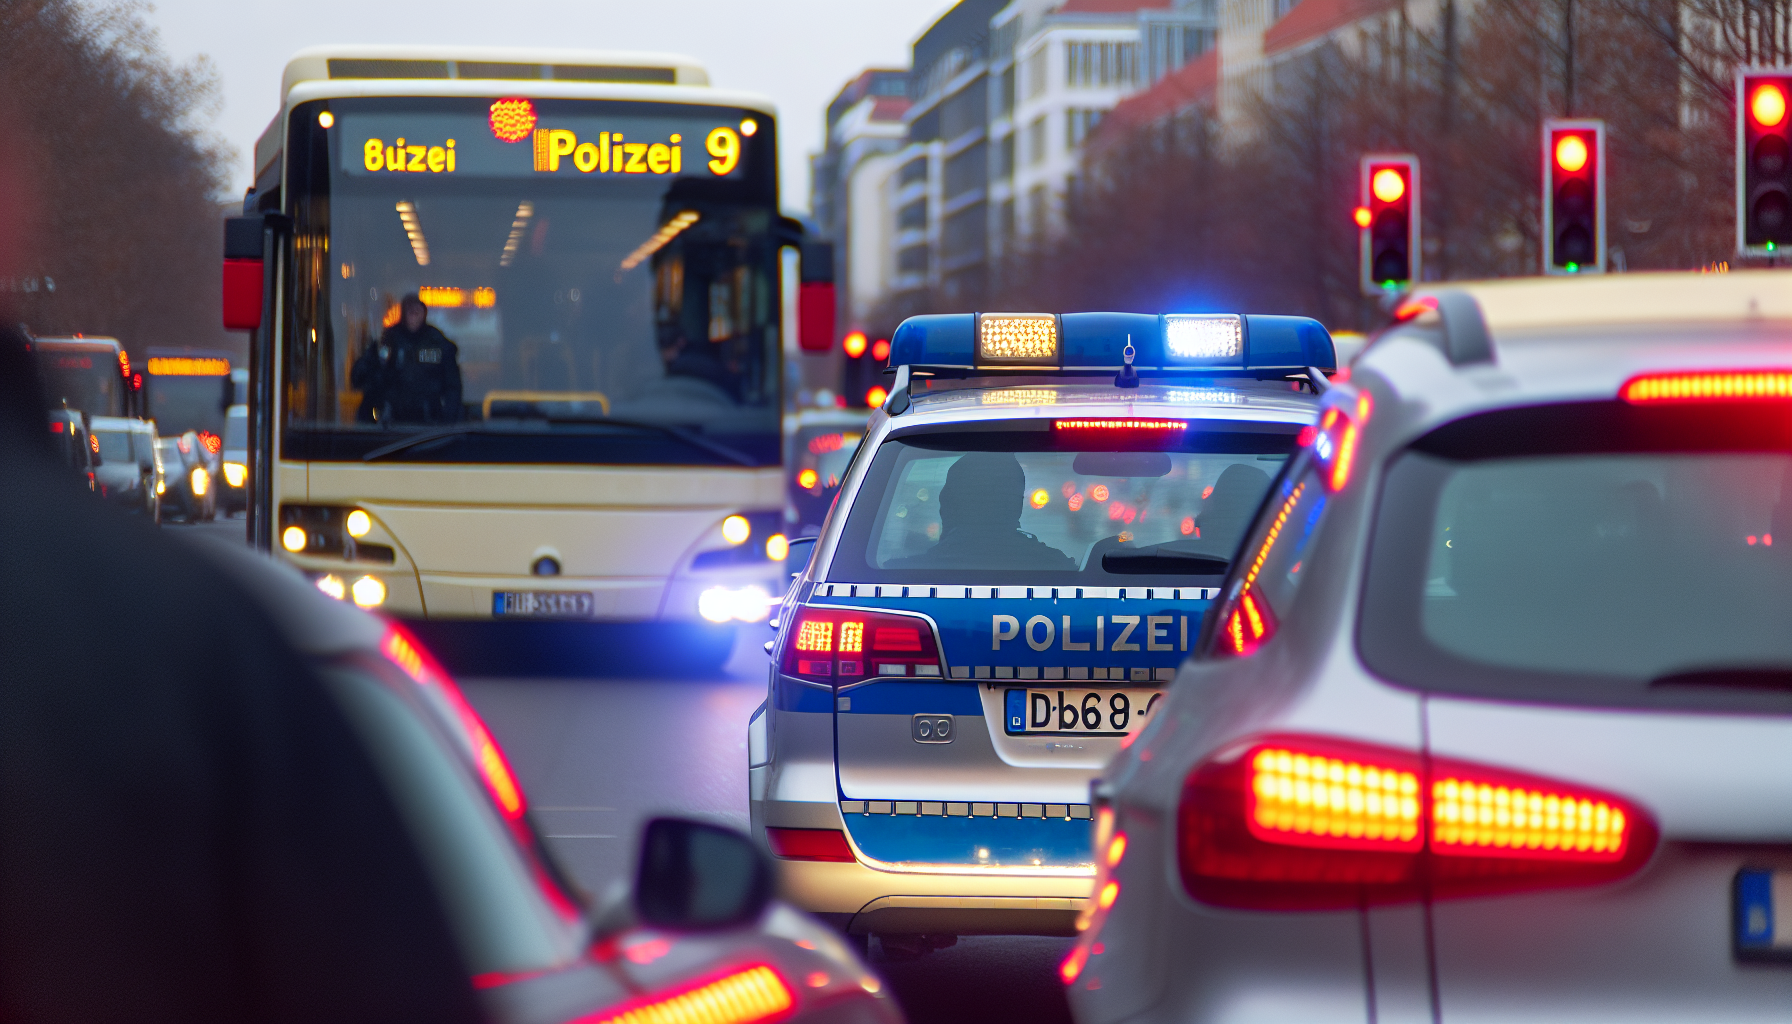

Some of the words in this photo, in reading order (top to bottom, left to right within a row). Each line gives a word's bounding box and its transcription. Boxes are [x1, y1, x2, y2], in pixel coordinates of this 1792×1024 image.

[549, 128, 682, 174] Polizei
[705, 126, 741, 176] 9
[992, 614, 1188, 652] POLIZEI
